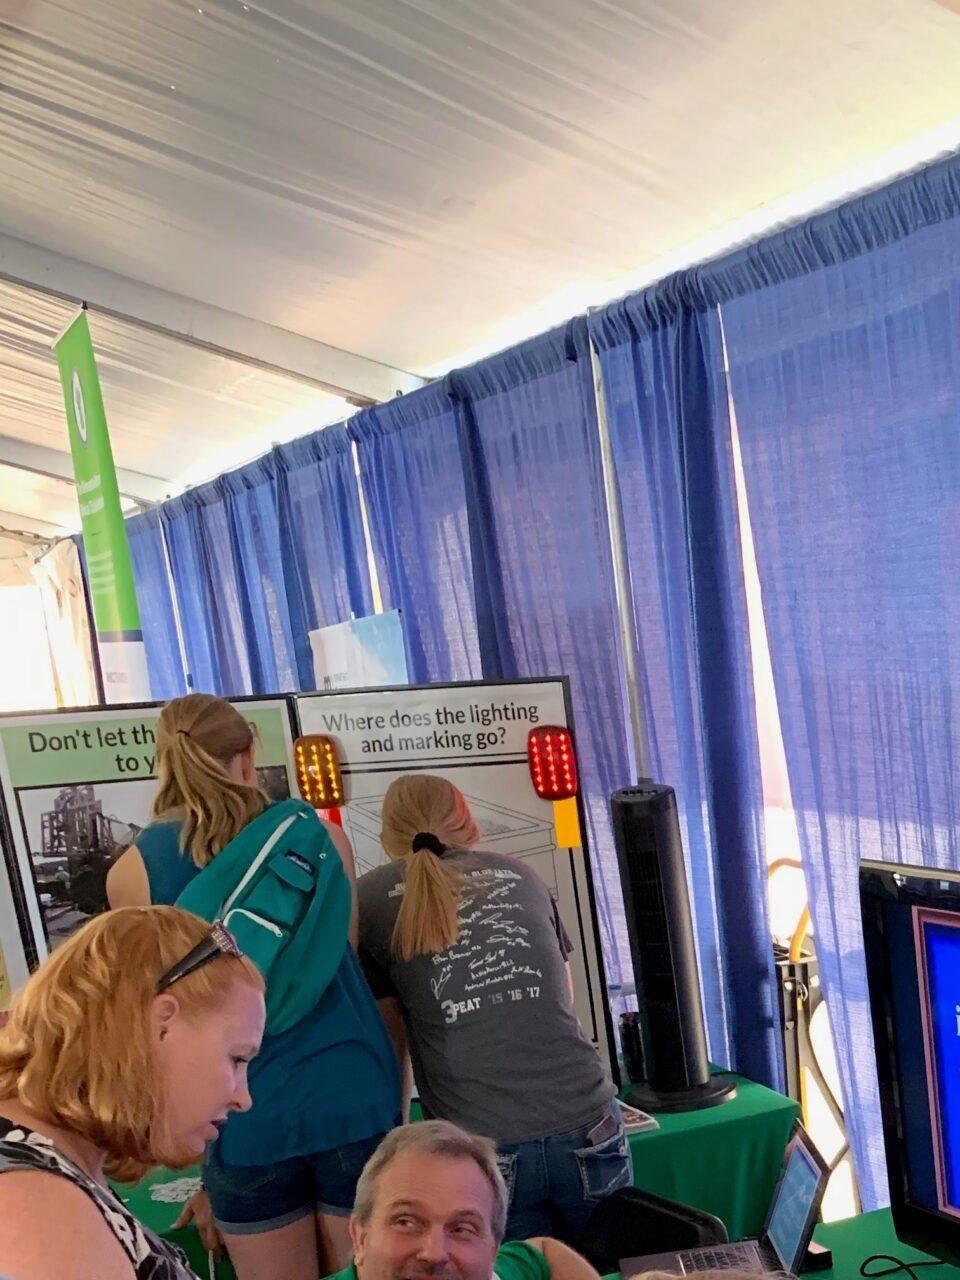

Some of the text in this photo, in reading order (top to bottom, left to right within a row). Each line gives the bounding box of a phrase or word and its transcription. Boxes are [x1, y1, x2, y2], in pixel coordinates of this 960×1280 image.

[323, 701, 539, 735] Where does the lighting
[29, 728, 92, 753] Don't
[97, 726, 126, 748] let
[361, 726, 506, 757] and marking go?
[114, 753, 139, 773] to
[507, 989, 522, 1001] '16
[527, 986, 541, 999] '17
